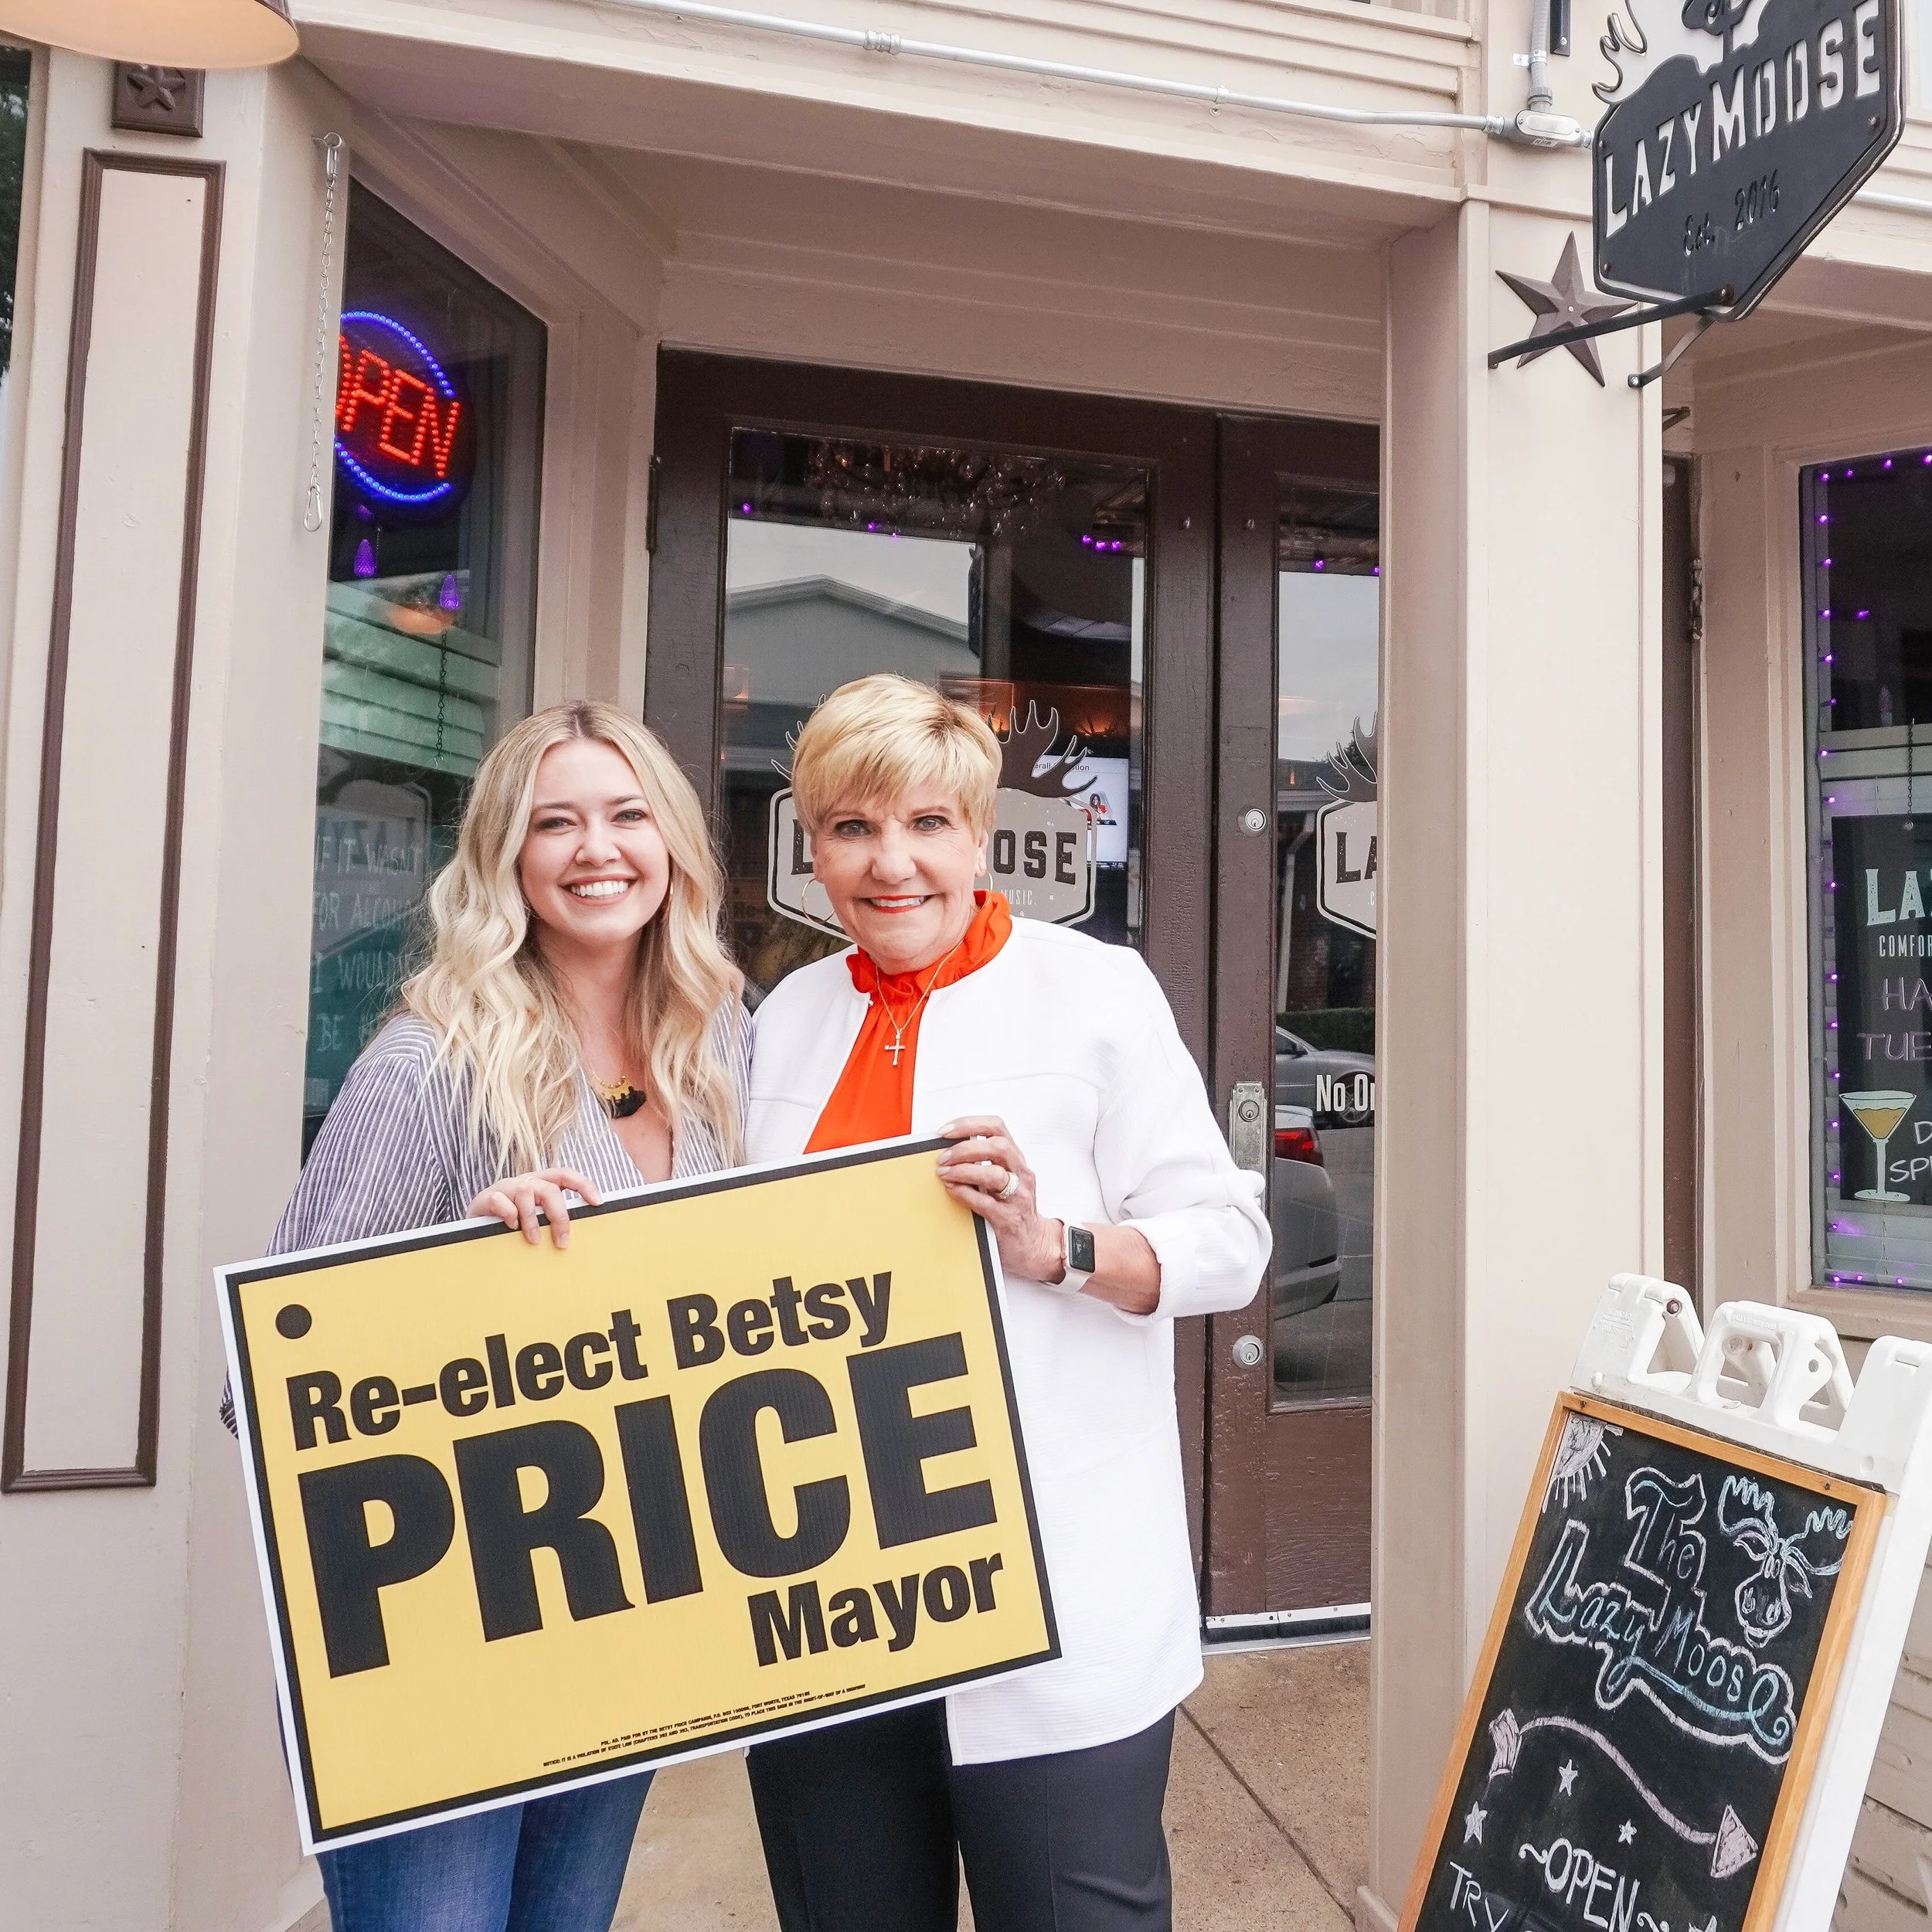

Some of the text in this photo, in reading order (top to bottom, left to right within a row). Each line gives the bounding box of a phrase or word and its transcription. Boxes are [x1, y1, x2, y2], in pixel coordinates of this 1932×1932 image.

[1733, 168, 1781, 232] 2016
[992, 828, 1077, 886] OSE
[1335, 832, 1377, 883] LA
[1865, 868, 1932, 926] LA
[1316, 1074, 1345, 1112] No
[285, 1271, 892, 1451] Re-elect Betsy
[298, 1331, 998, 1679] PRICE
[1632, 1478, 1696, 1580] The
[747, 1552, 1004, 1668] Mayor
[1539, 1543, 1646, 1696] Lazy
[543, 1758, 560, 1767] NOTICE:
[576, 1748, 600, 1758] VIOLATION
[689, 1717, 728, 1730] TRANSPORTATION
[687, 1714, 713, 1724] CAMPAIGN,
[1449, 1861, 1509, 1932] TRY
[1545, 1837, 1641, 1932] OPEN
